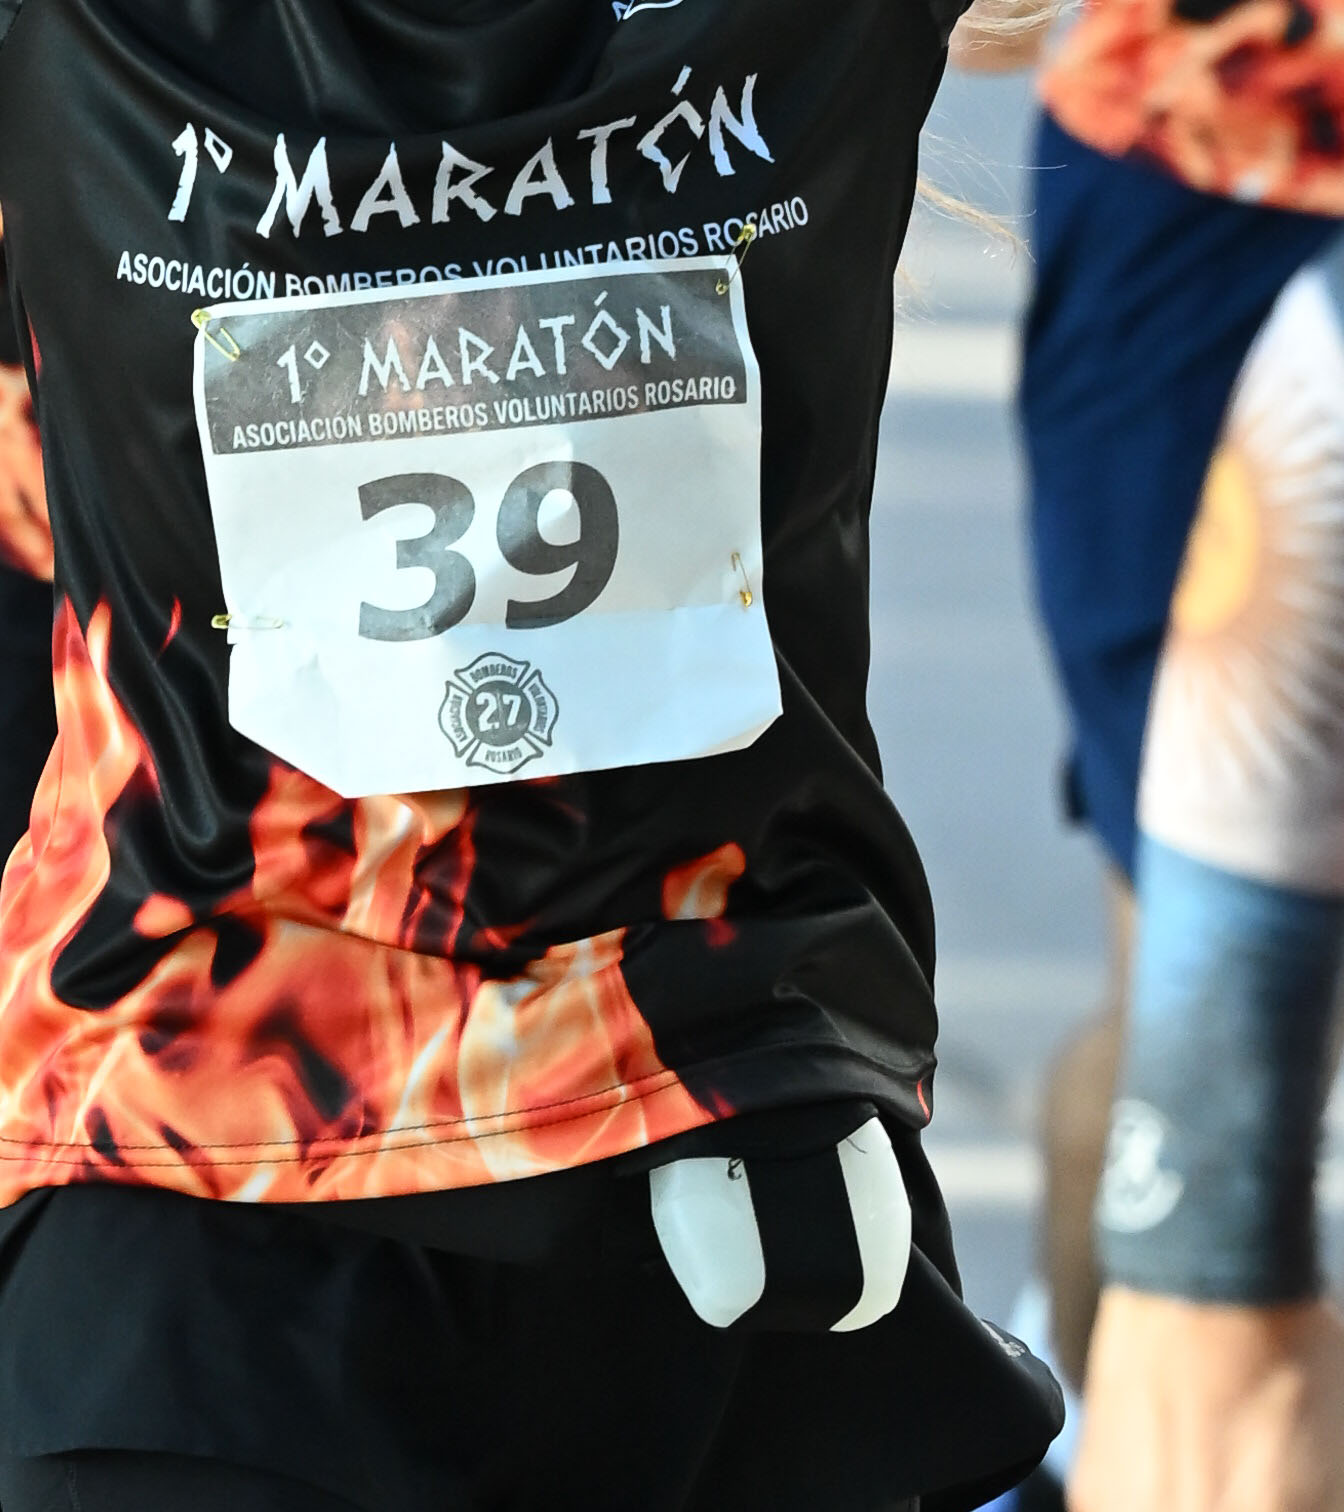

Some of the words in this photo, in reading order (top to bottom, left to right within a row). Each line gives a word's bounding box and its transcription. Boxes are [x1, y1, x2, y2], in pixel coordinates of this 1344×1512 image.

[256, 65, 776, 238] MARATÓN
[116, 250, 276, 300] ASOCIACIÓN
[703, 196, 810, 253] ROSARIO
[358, 291, 678, 397] MARATÓN
[369, 401, 489, 436] BOMBEROS
[493, 385, 639, 424] VOLUNTARIOS
[644, 375, 737, 407] ROSARIO
[355, 459, 621, 645] 39
[476, 691, 522, 732] 27
